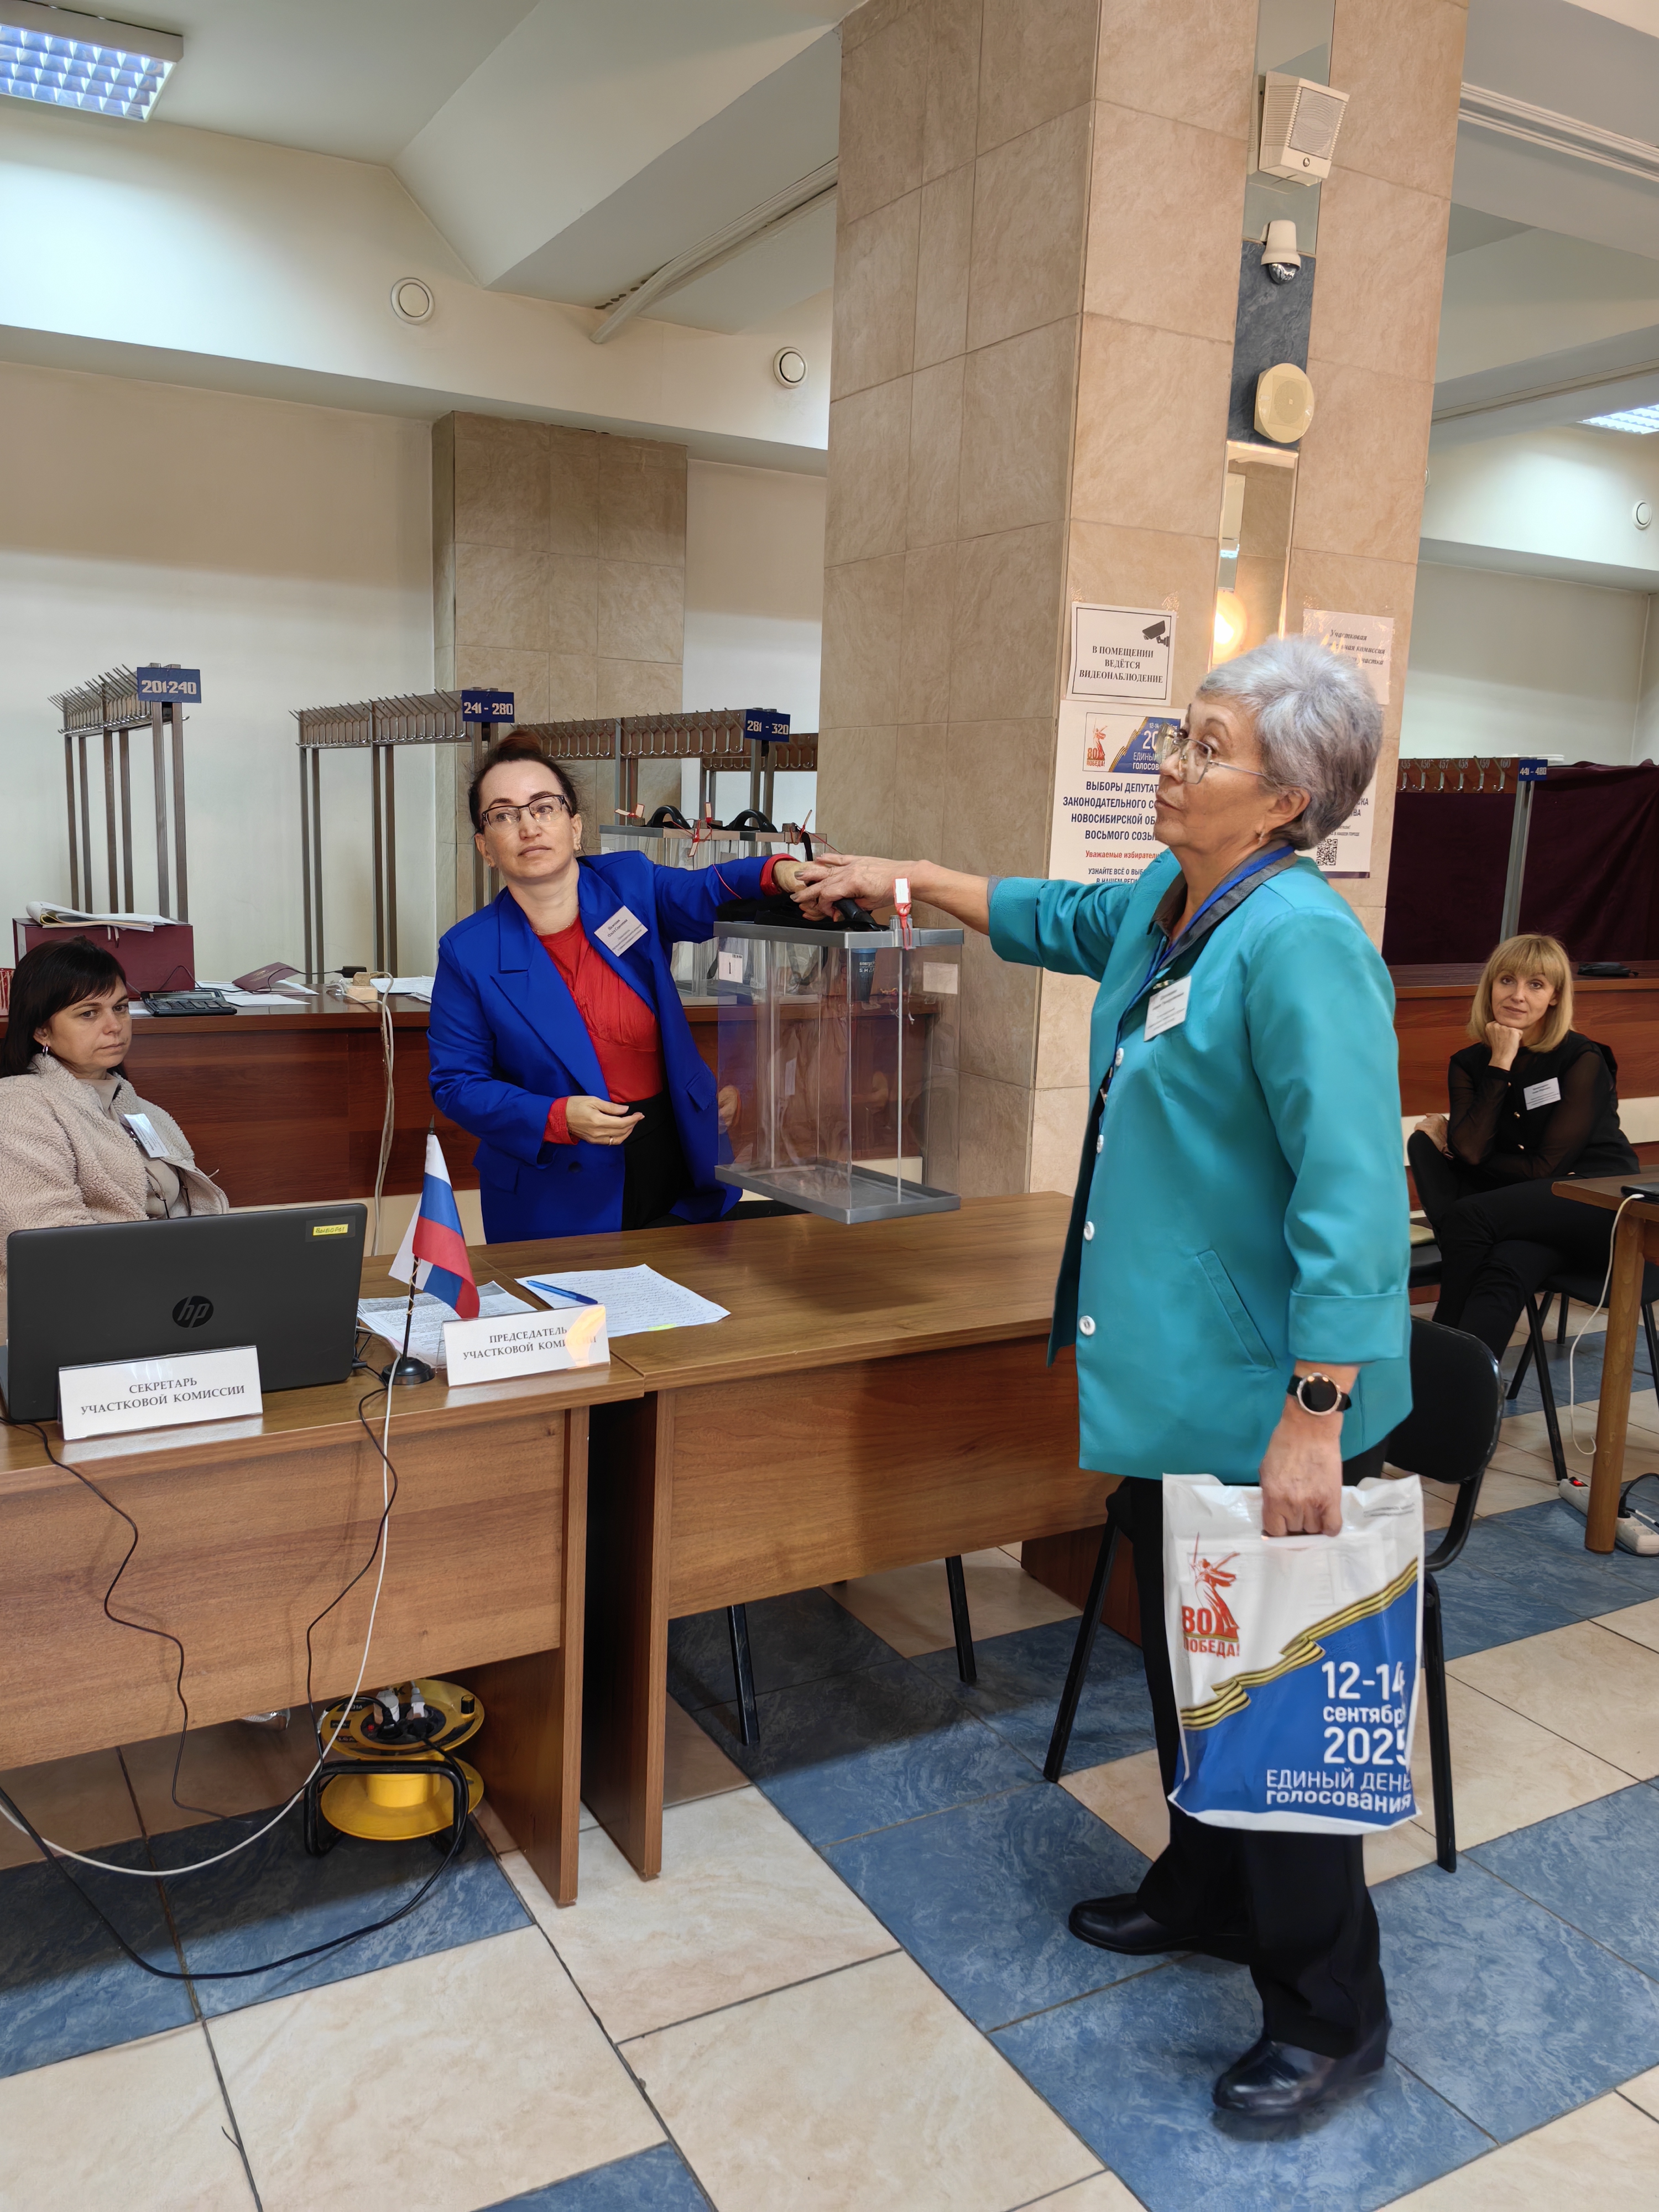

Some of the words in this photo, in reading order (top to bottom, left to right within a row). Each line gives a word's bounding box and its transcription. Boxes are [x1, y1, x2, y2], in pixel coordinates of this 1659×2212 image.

[1330, 629, 1368, 641] Участковая
[1093, 645, 1098, 654] В
[1099, 646, 1154, 658] ПОМЕЩЕНИИ
[1356, 646, 1386, 655] комиссия
[1105, 659, 1140, 669] ВЕДЁТСЯ
[1079, 670, 1163, 684] ВИДЕОНАБЛЮДЕНИЕ
[464, 702, 482, 714] 241
[492, 703, 513, 715] 280
[747, 720, 762, 732] 281
[771, 723, 789, 735] 320
[1520, 767, 1530, 775] 441
[1535, 767, 1547, 775] 480
[1086, 781, 1123, 791] ВЫБОРЫ
[1124, 782, 1159, 794] ДЕПУТАТ
[1063, 796, 1146, 808] ЗАКОНОДАТЕЛЬНОГО
[1071, 813, 1142, 825] НОВОСИБИРСКОЙ
[1085, 830, 1130, 841] ВОСЬМОГО
[1131, 831, 1155, 841] СОЗЫ
[1086, 850, 1123, 858] Уважаемые
[177, 1296, 210, 1328] hp
[489, 1327, 567, 1343] ПРЕДСЕДАТЕЛЬ
[463, 1342, 534, 1360] УЧАСТКОВОЙ
[129, 1378, 197, 1394] СЕКРЕТАРЬ
[81, 1395, 168, 1415] УЧАСТКОВОЙ
[173, 1385, 245, 1403] КОМИССИИ
[1183, 1637, 1240, 1659] ПОБЕДА!
[1322, 1661, 1405, 1701] 12-14
[1323, 1704, 1406, 1729] сентябр
[1266, 1767, 1354, 1790] ЕДИНЫЙ
